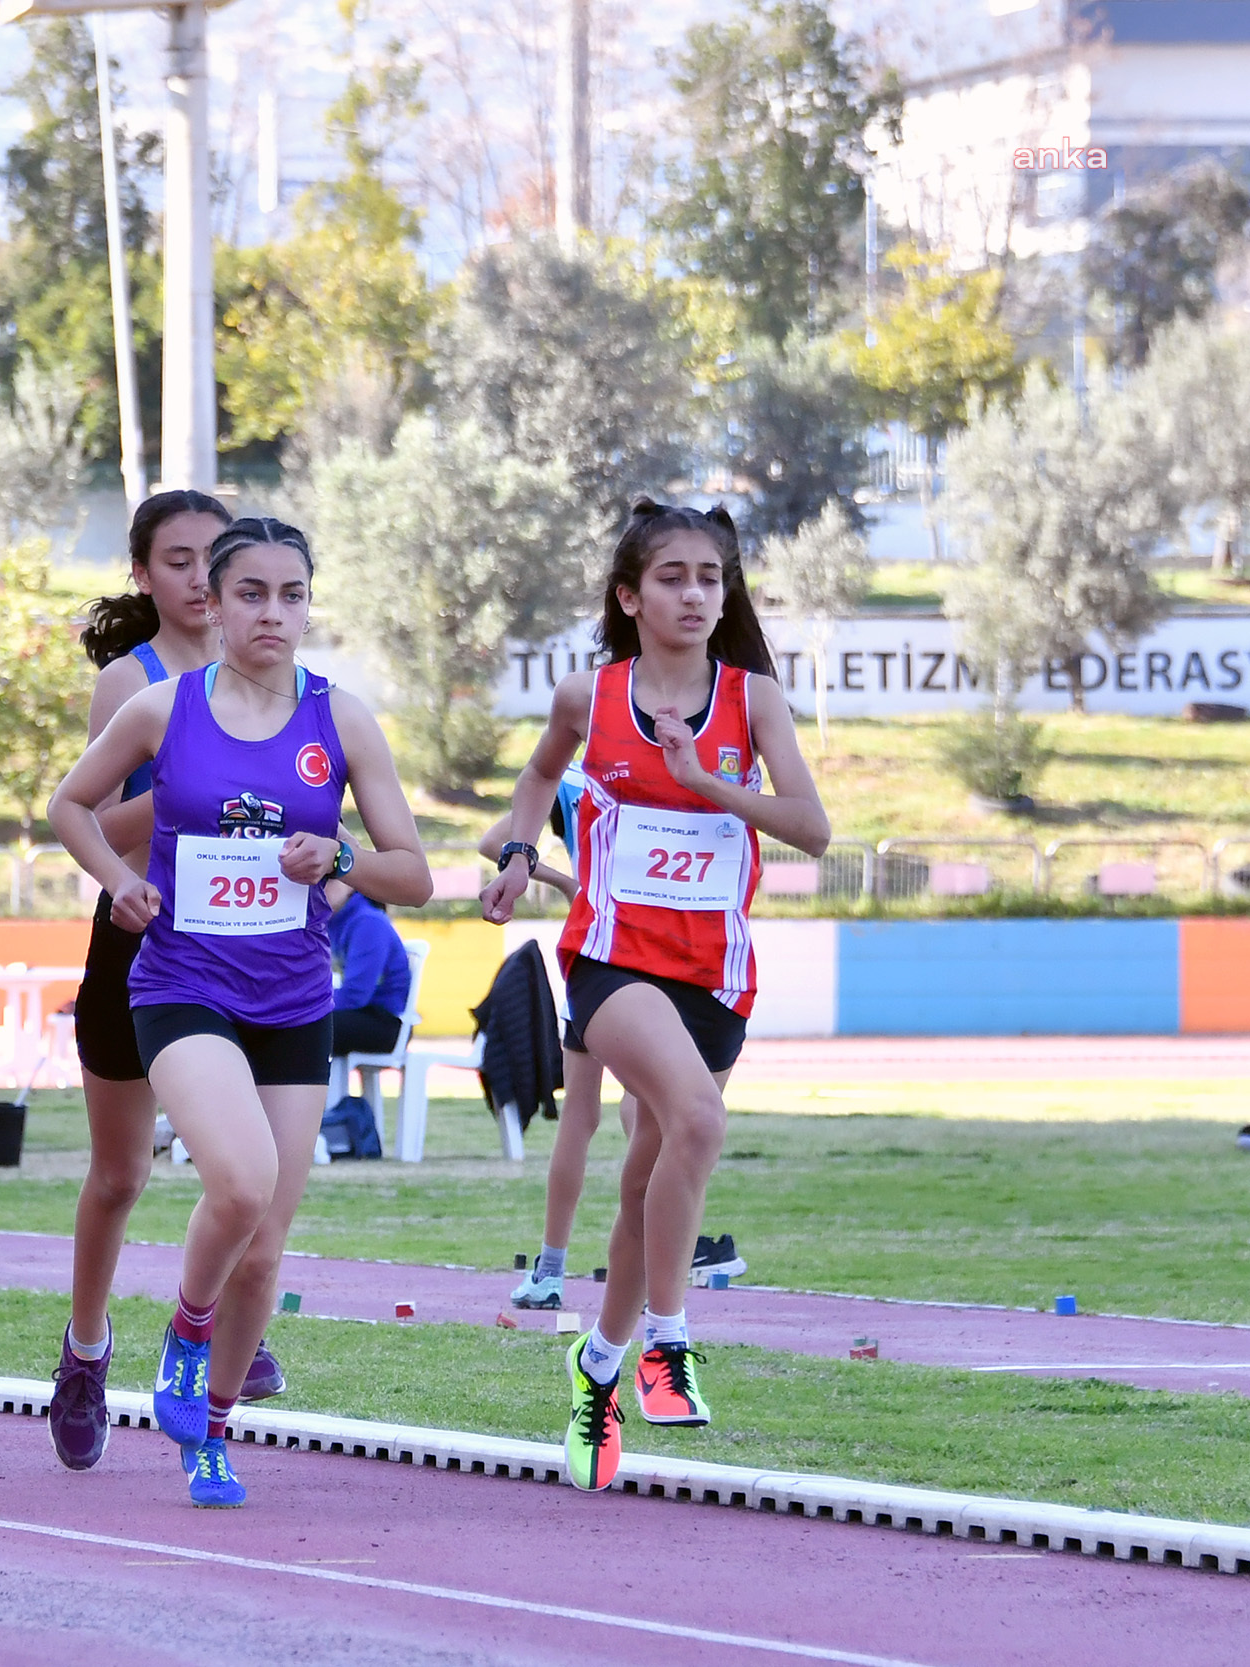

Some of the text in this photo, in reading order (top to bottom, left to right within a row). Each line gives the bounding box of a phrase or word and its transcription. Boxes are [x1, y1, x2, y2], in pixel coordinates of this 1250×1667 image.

[637, 823, 699, 836] OKUL SPORLARI
[196, 853, 219, 861] OKUL
[645, 848, 715, 883] 227
[208, 876, 279, 908] 295
